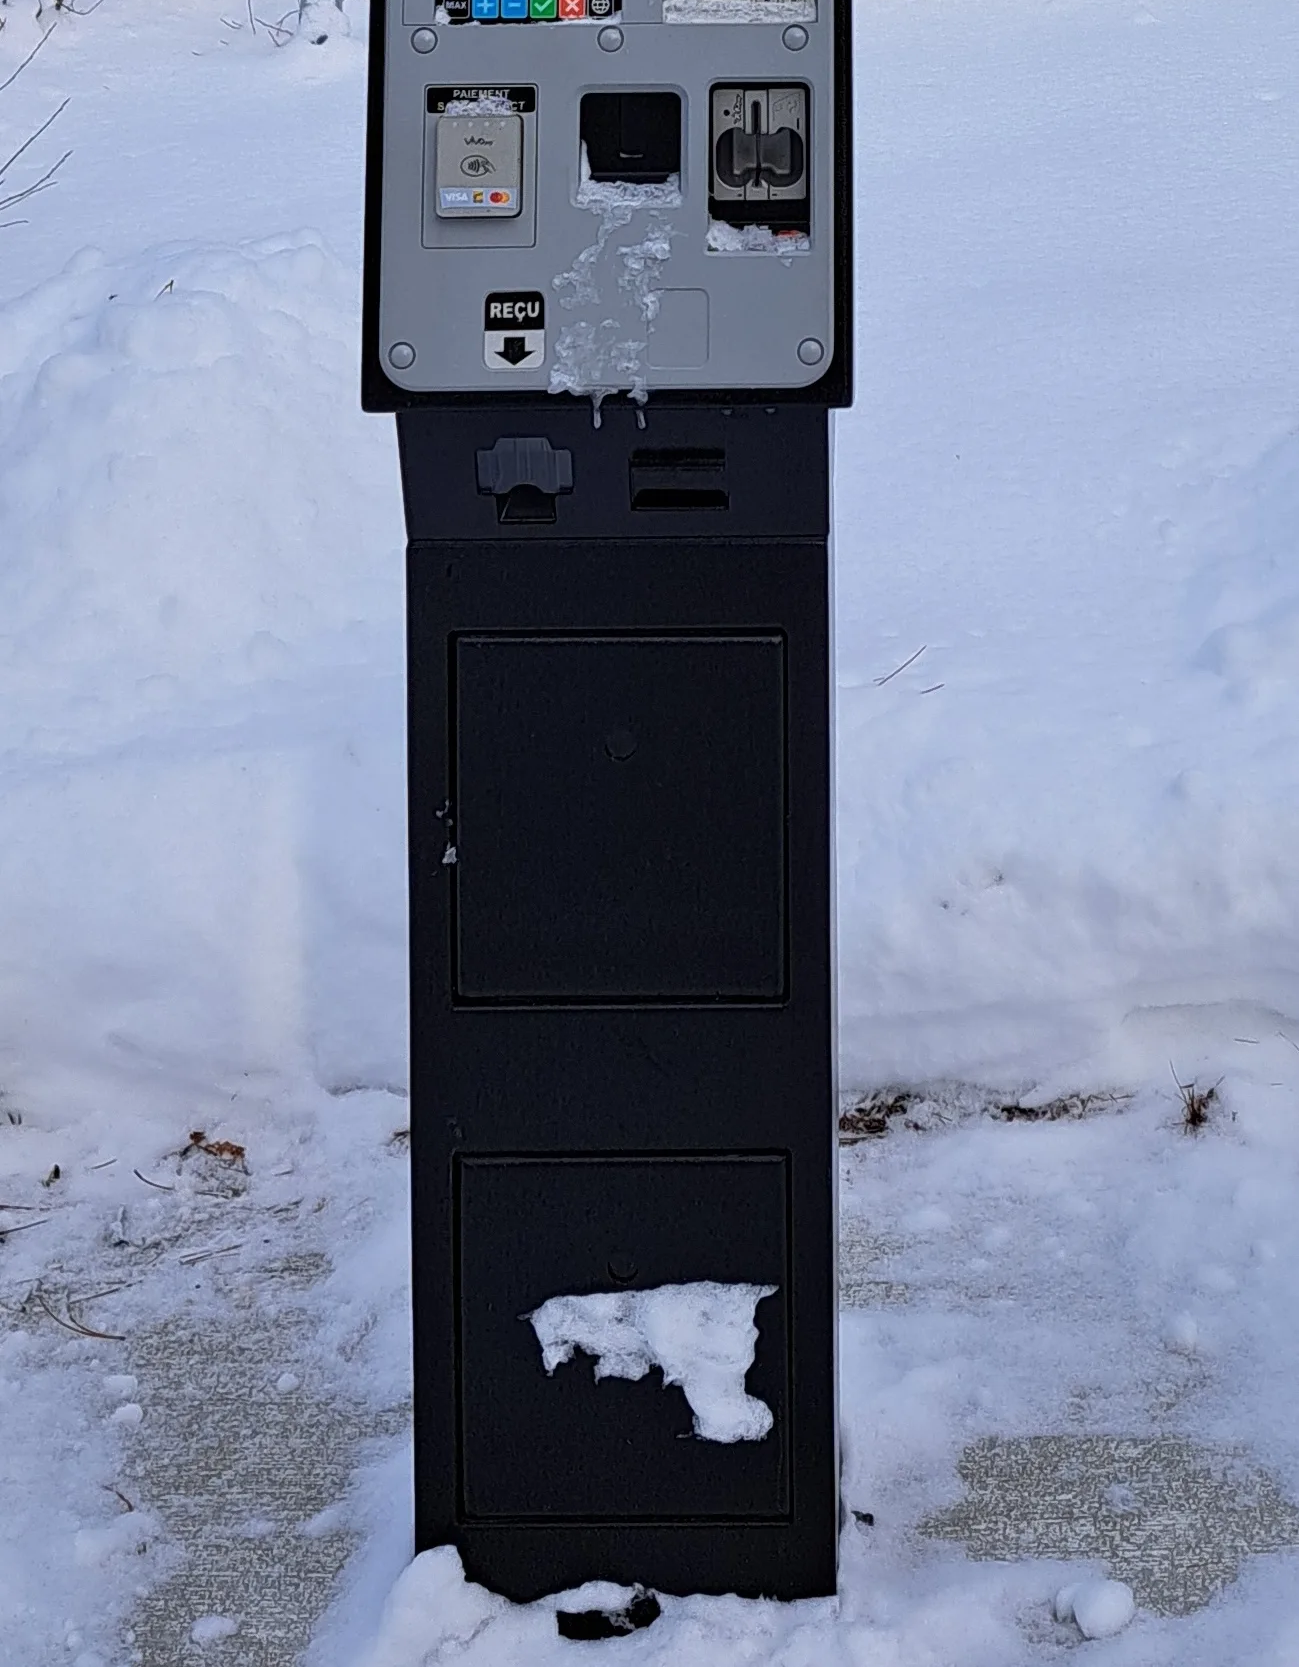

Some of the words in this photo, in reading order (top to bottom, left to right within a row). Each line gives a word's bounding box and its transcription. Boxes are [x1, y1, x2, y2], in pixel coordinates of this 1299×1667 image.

[453, 90, 510, 99] PAIEMENT
[445, 193, 468, 202] VISA
[490, 303, 540, 321] REÇU
